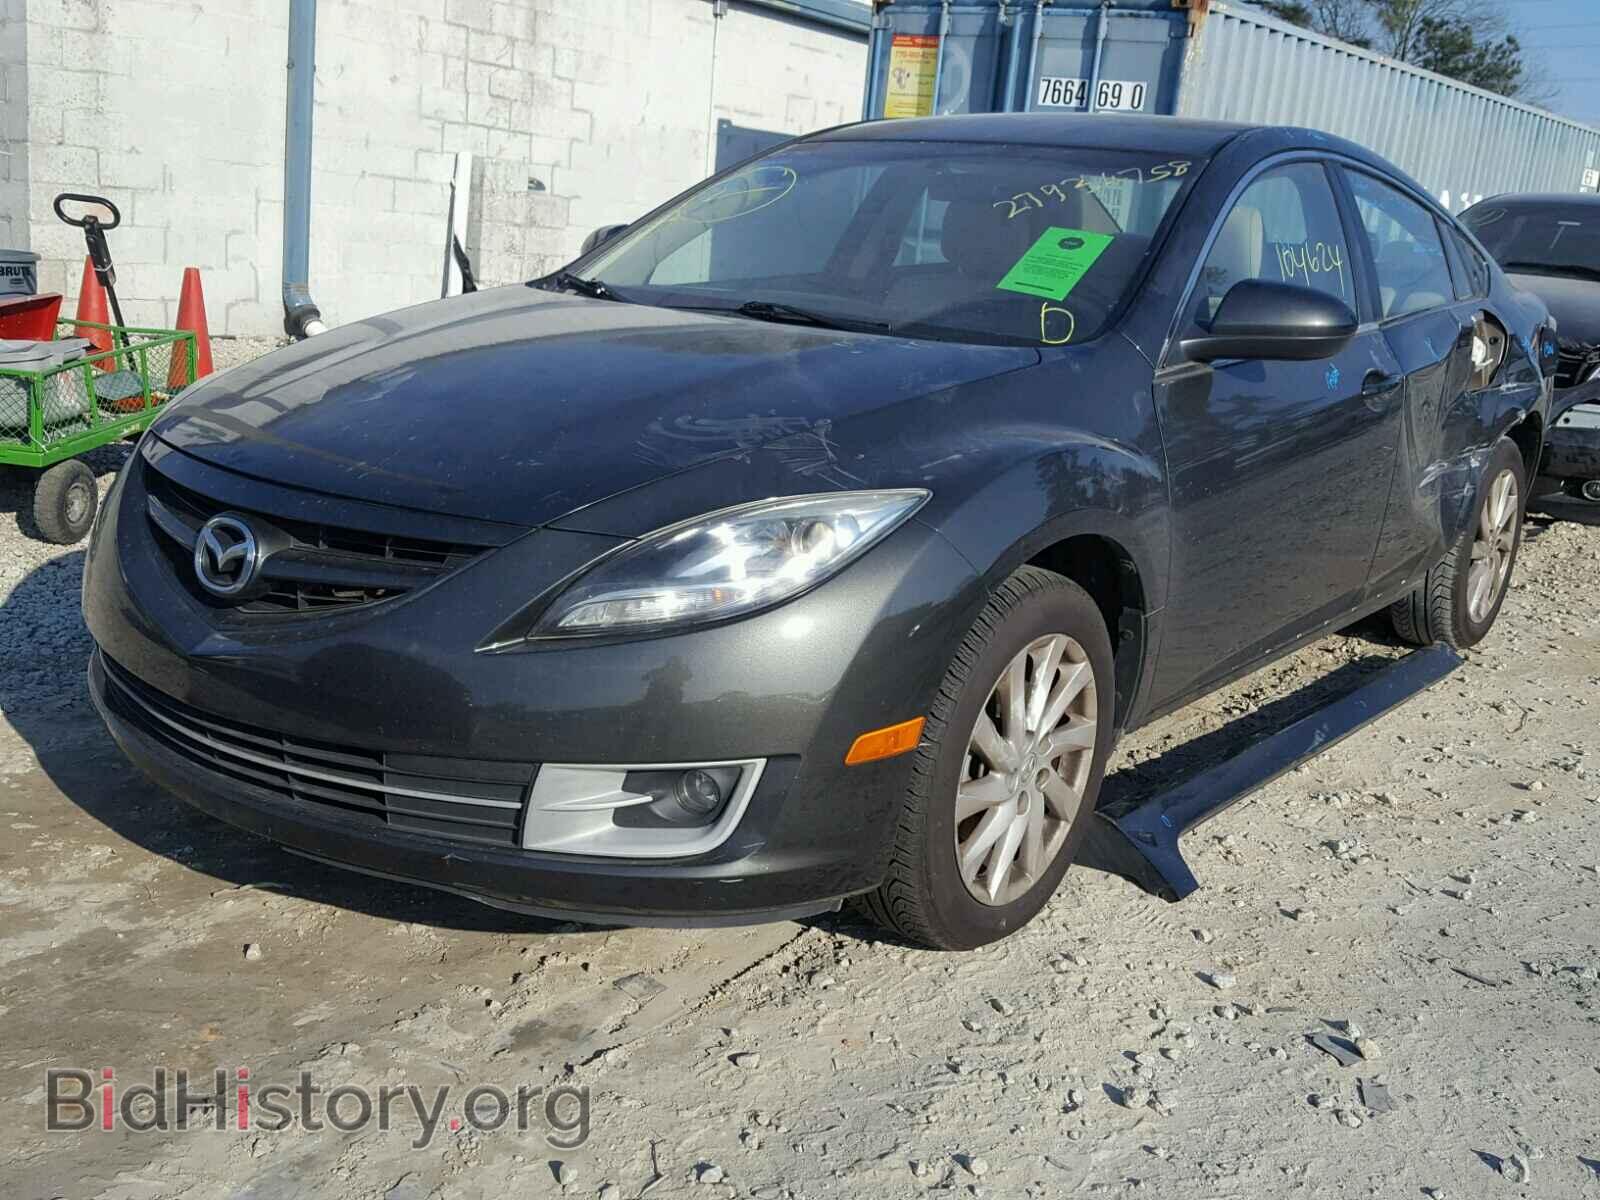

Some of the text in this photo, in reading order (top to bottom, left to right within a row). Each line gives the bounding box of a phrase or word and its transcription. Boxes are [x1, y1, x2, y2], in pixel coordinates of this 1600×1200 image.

[1041, 79, 1144, 109] 7664 69 0
